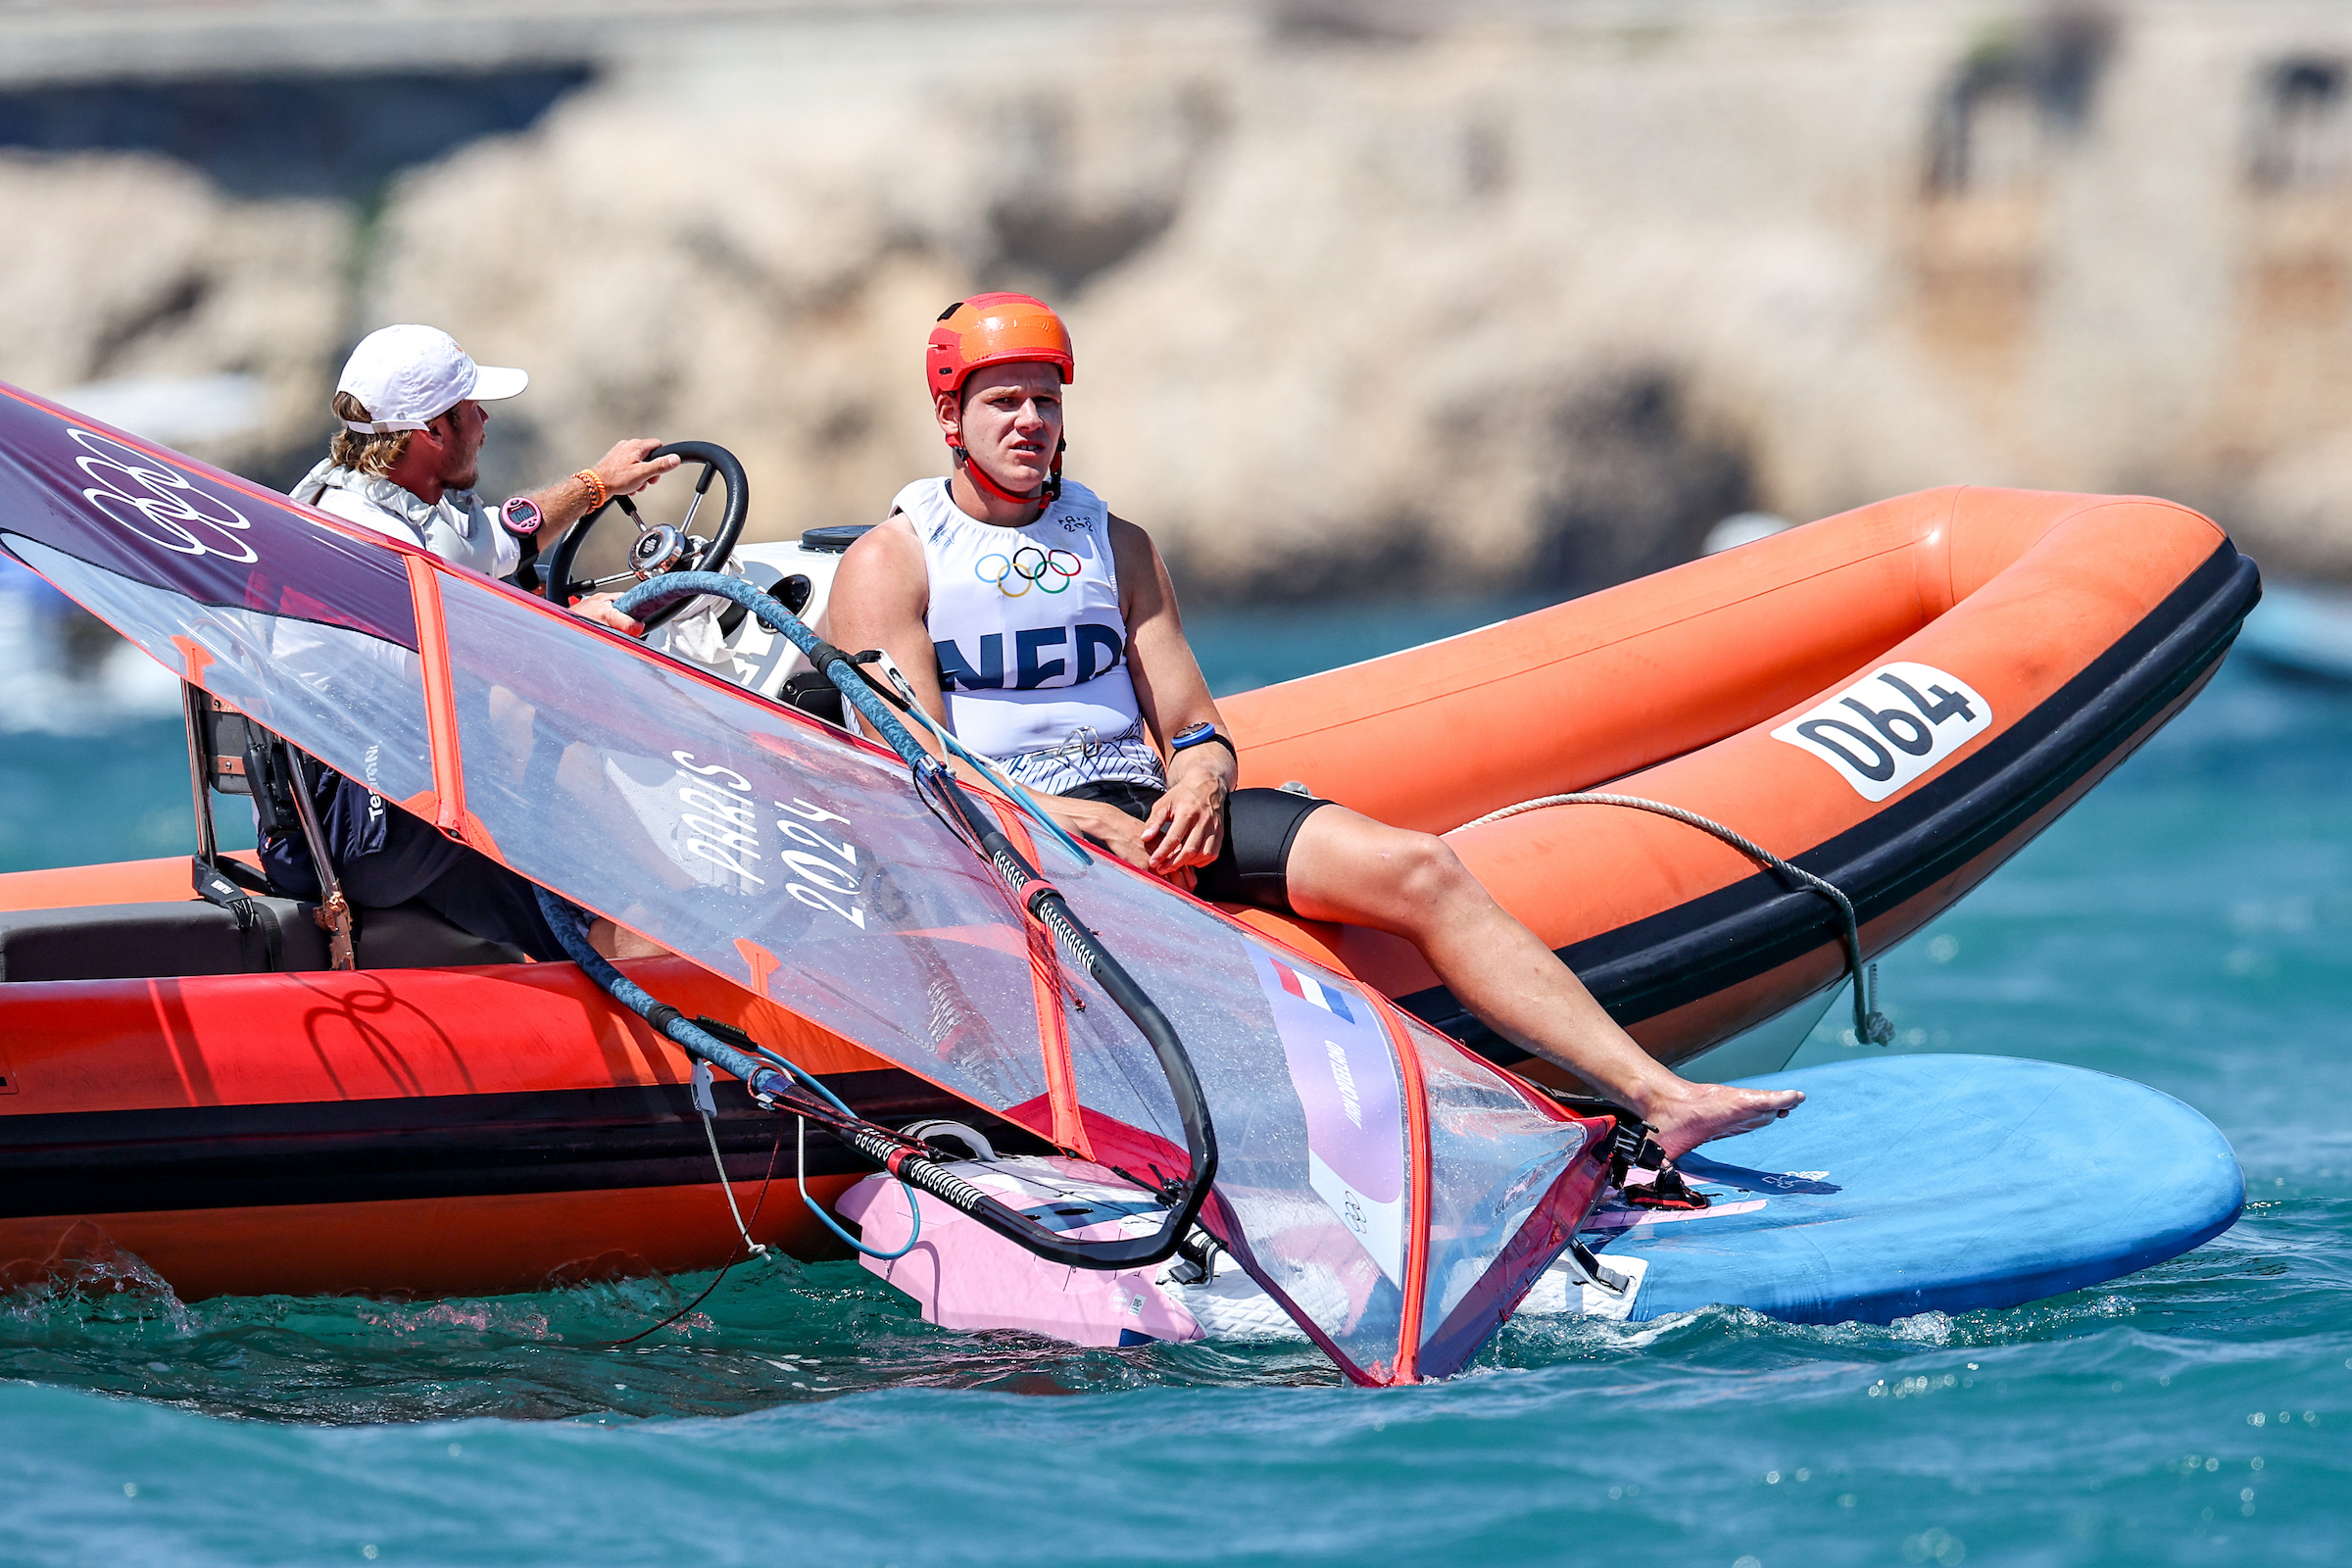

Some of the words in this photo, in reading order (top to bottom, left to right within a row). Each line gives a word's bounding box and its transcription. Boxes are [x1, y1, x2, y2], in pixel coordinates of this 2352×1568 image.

[933, 624, 1123, 692] NED
[671, 750, 765, 885] PARIS
[774, 797, 866, 930] 2024
